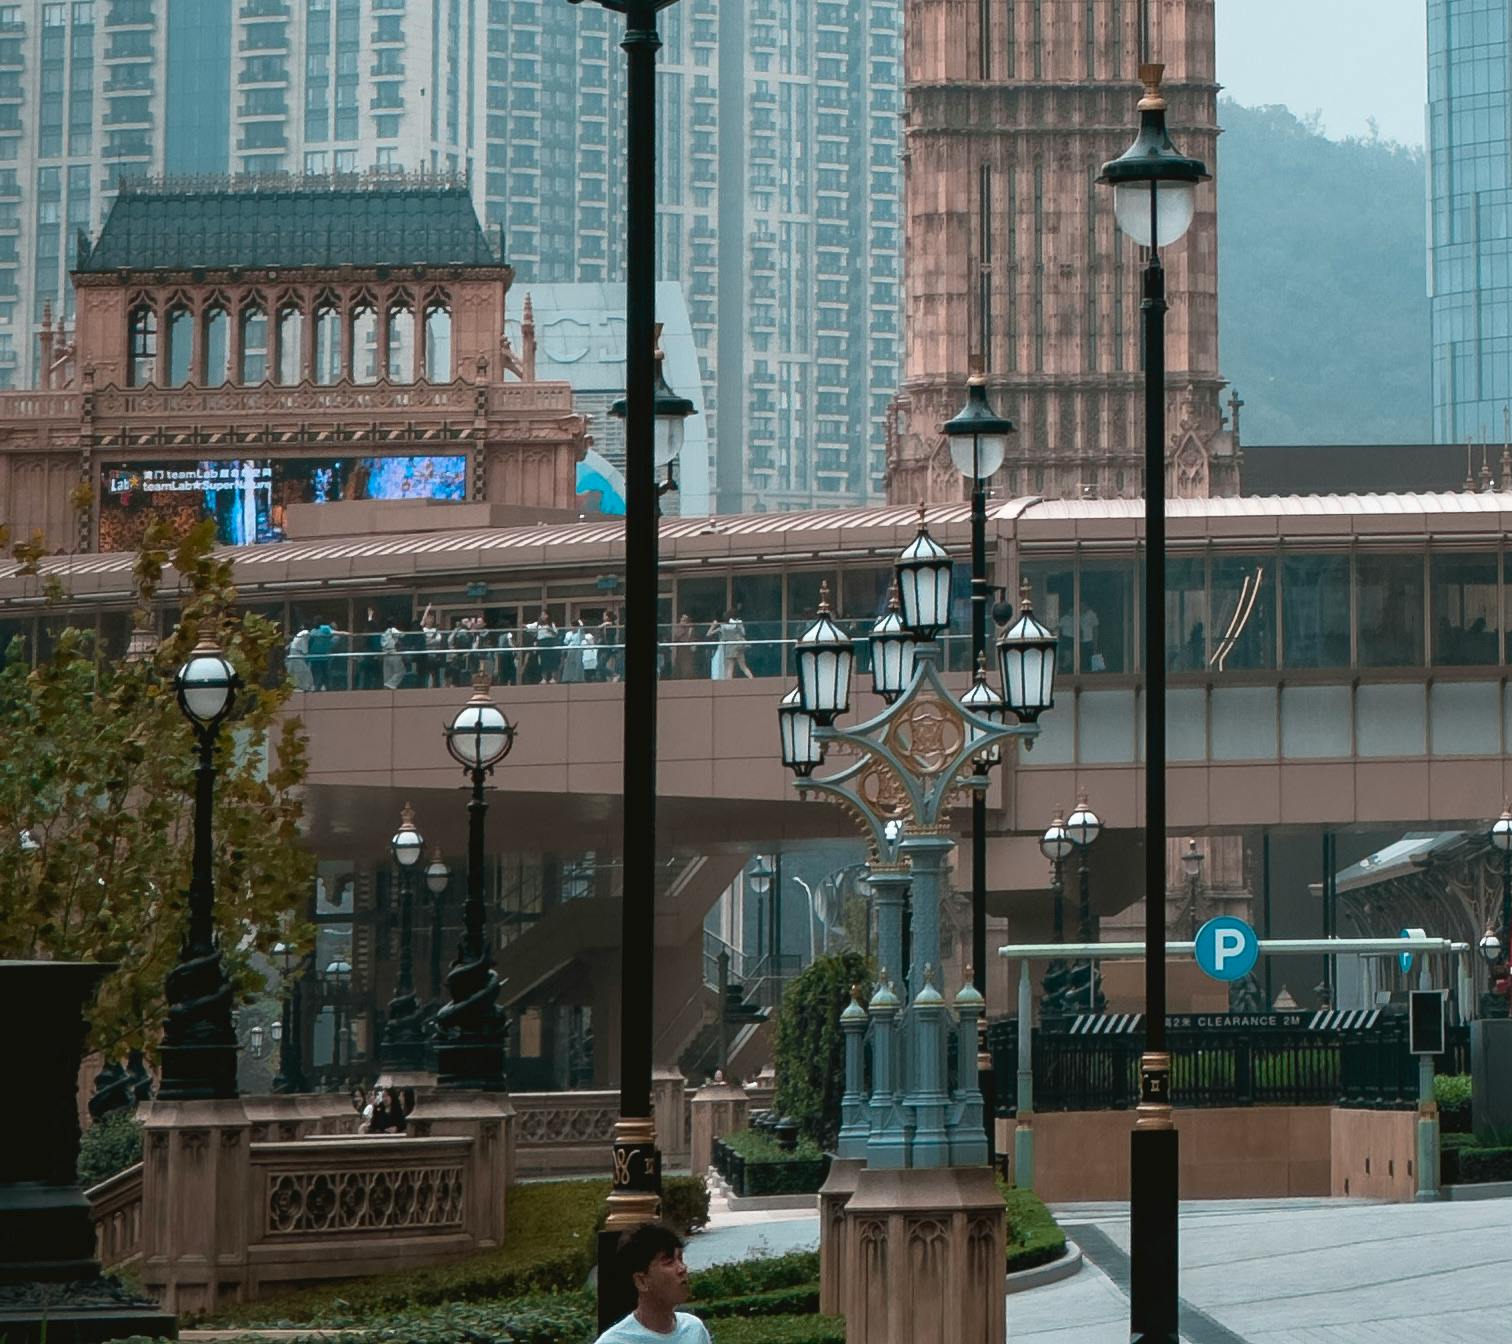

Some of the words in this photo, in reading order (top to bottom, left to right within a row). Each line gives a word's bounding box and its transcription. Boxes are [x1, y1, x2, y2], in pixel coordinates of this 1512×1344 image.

[1215, 928, 1246, 970] P
[1197, 1015, 1277, 1027] CLEARANCE
[1283, 1015, 1300, 1026] 2M
